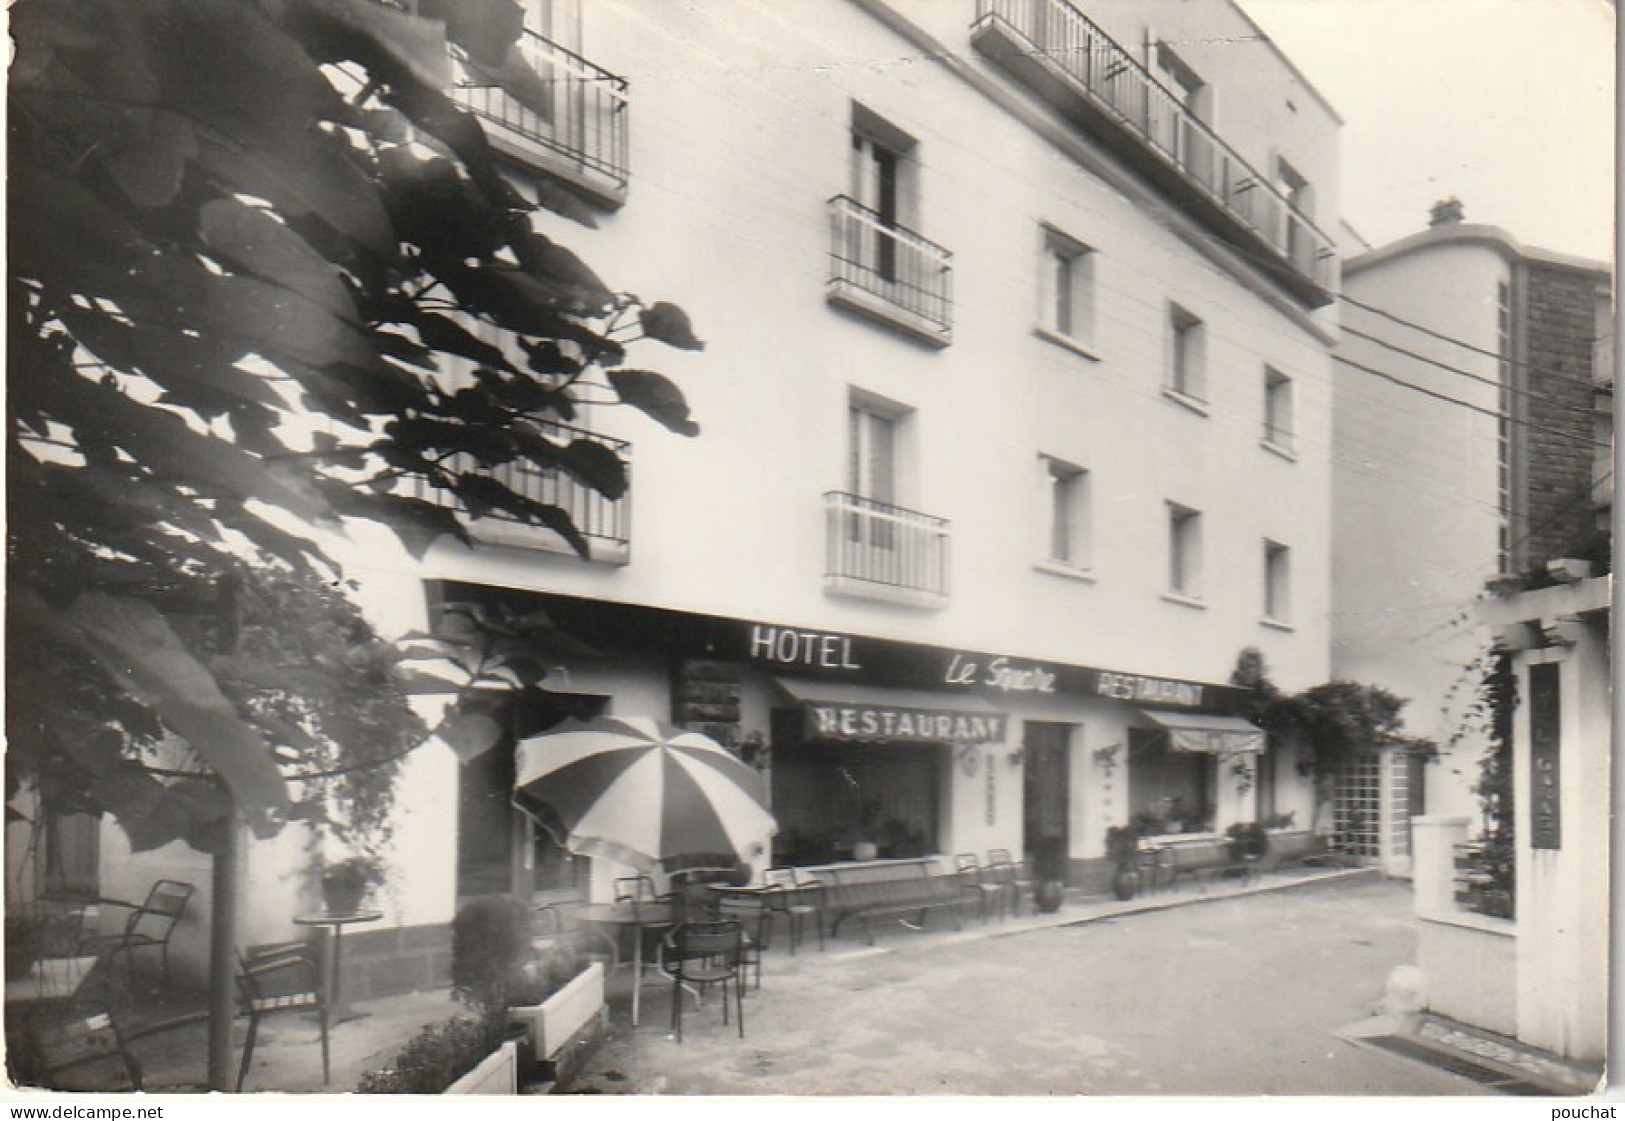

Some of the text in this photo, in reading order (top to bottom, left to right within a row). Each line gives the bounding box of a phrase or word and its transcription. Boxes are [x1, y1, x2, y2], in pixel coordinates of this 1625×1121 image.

[750, 624, 861, 670] HOTEL
[945, 654, 977, 684] Le
[1097, 671, 1204, 706] RESTAURANT
[815, 706, 1001, 740] RESTAURANT
